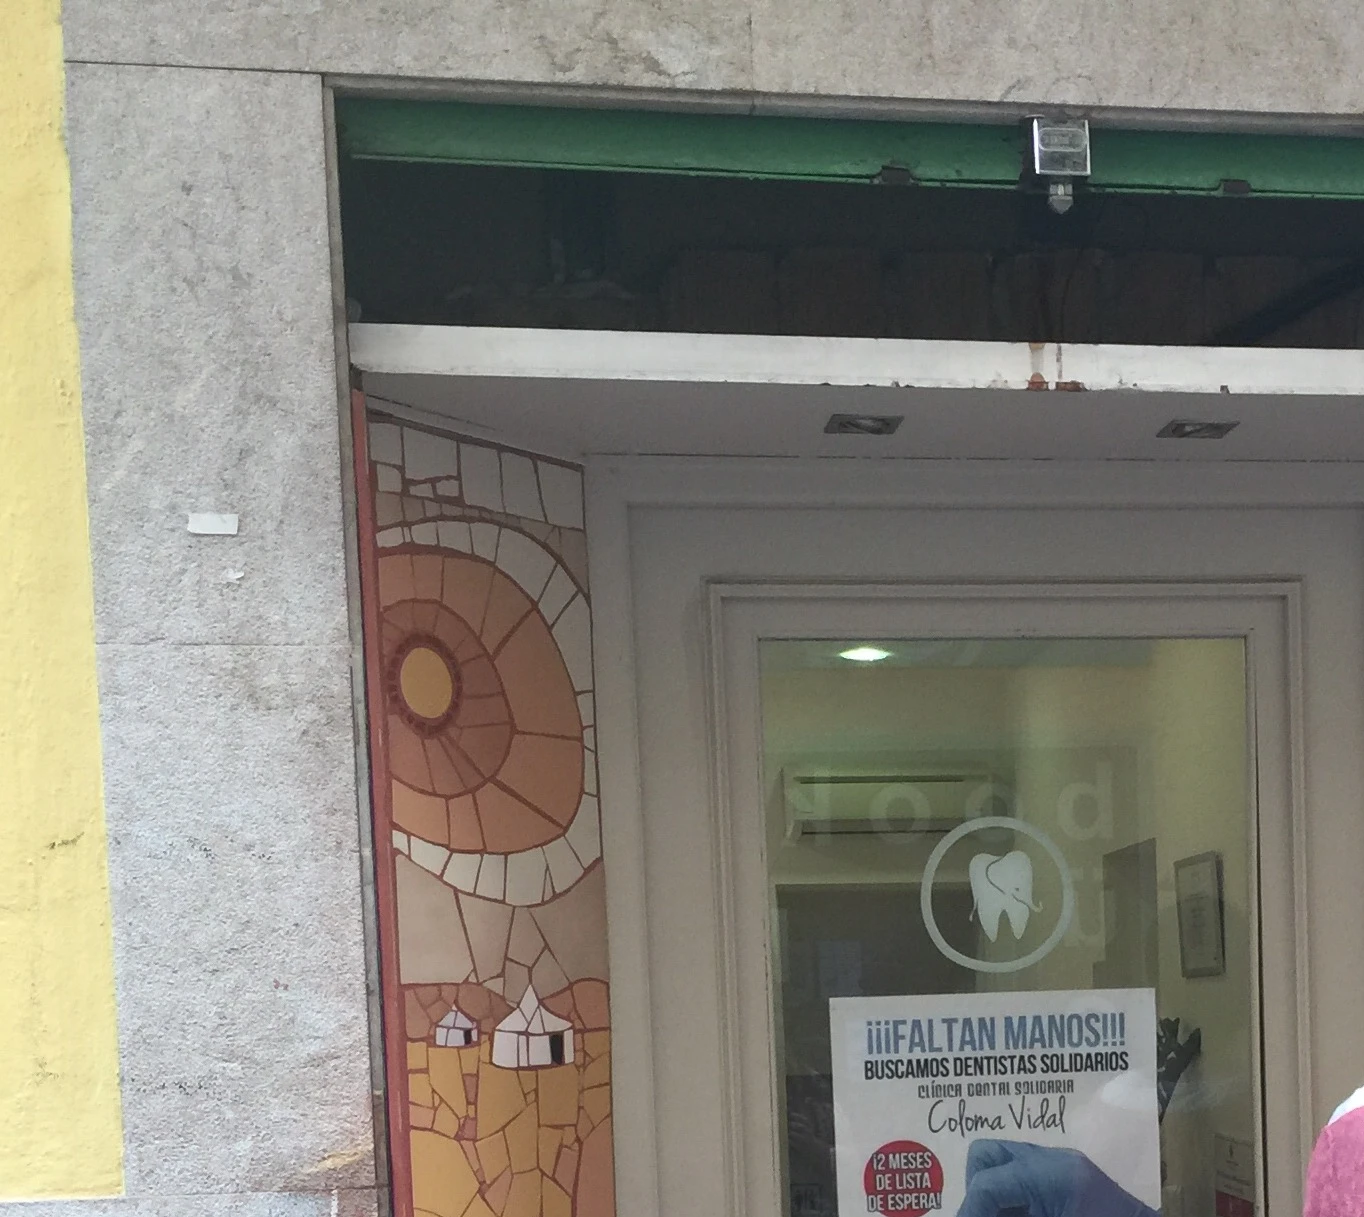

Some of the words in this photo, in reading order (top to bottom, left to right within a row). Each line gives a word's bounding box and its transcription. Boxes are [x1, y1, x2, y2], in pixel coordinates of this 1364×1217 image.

[866, 1017, 995, 1055] ¡¡¡FALTAN
[1004, 1012, 1125, 1051] MANOS!!!
[864, 1057, 950, 1080] BUSCAMOS
[953, 1054, 1037, 1076] DENTISTAS
[1040, 1051, 1129, 1074] SOLIDARIOS
[967, 1081, 1012, 1098] DENTAL
[1014, 1079, 1075, 1096] SOLIDARIA
[928, 1099, 1006, 1138] Coloma
[1009, 1095, 1067, 1134] Vidal
[889, 1152, 932, 1170] MESES
[875, 1174, 893, 1191] DE
[896, 1172, 931, 1189] LISTA
[867, 1194, 884, 1212] DE
[888, 1192, 942, 1210] ESPERA!
